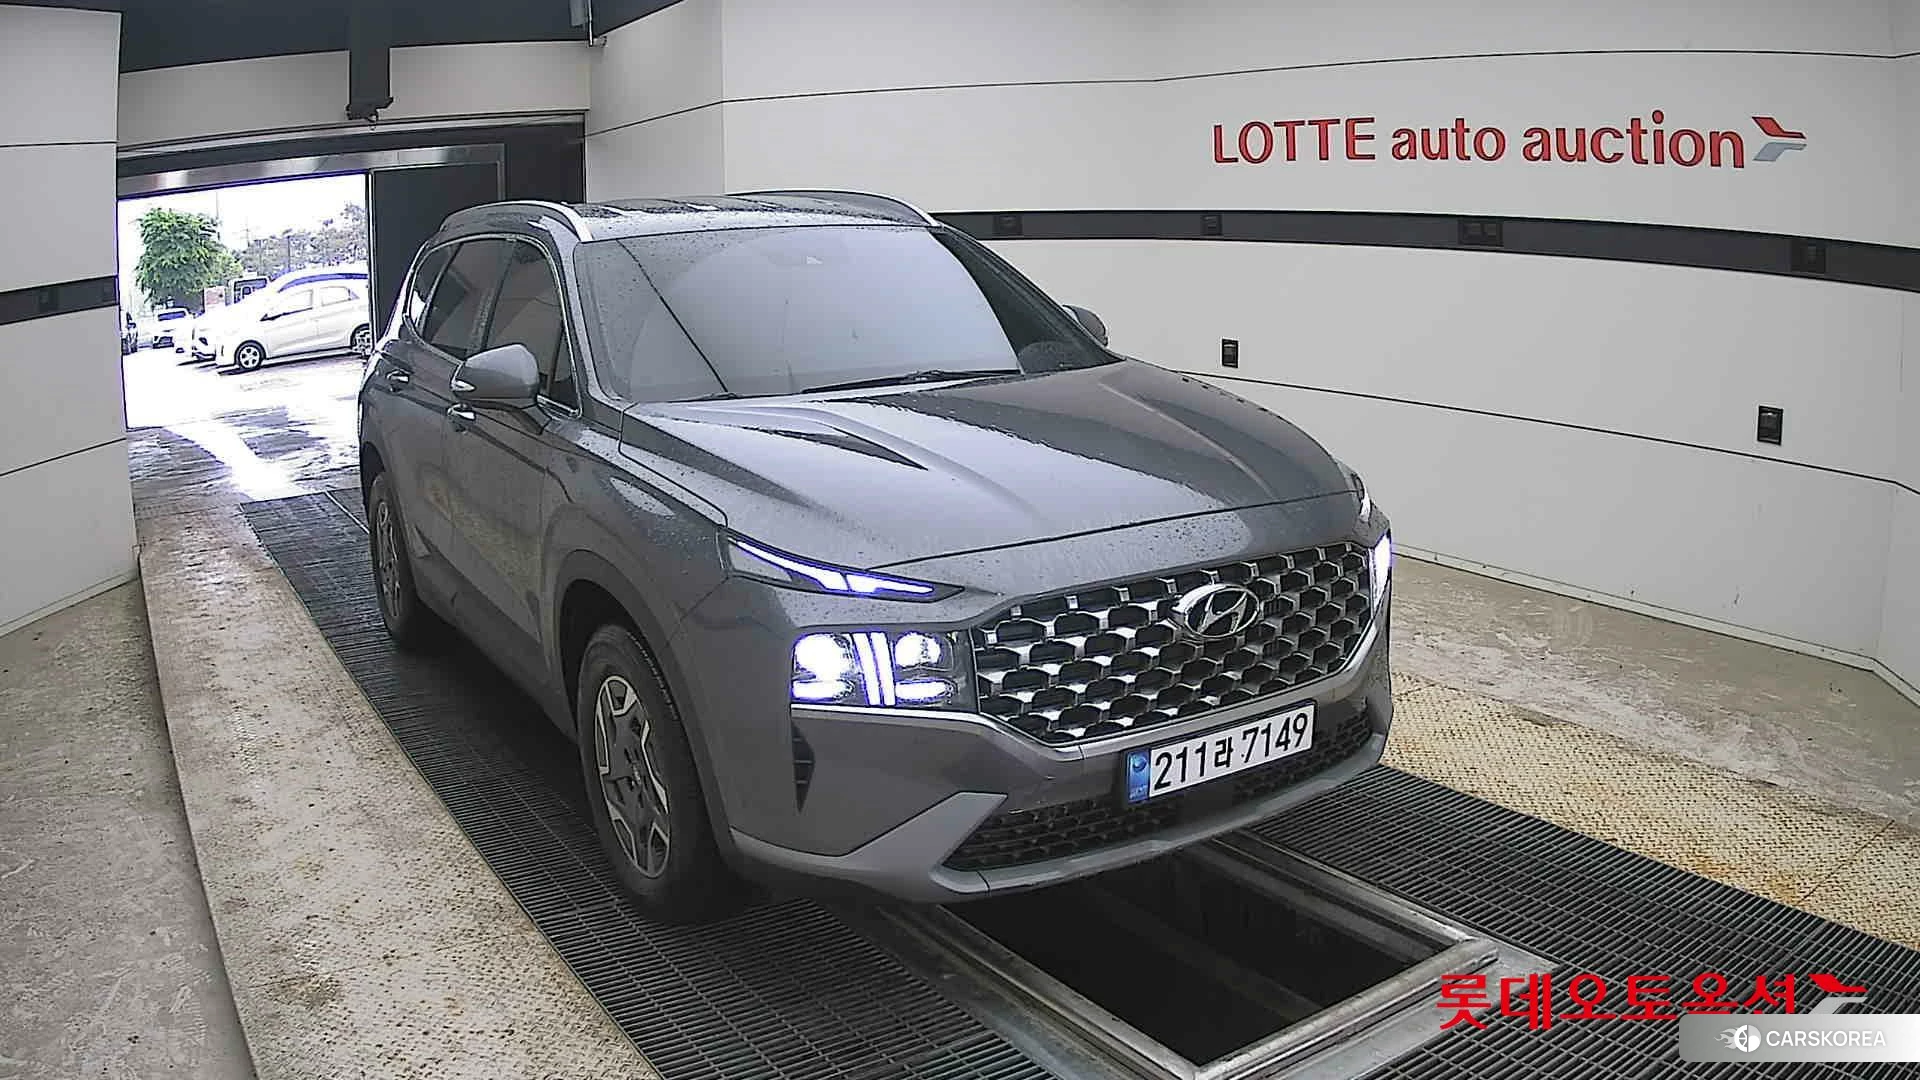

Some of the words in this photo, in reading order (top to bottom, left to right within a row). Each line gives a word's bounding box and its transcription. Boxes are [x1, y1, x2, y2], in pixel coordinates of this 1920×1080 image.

[1212, 116, 1376, 164] LOTTE
[1391, 117, 1507, 162] auto
[1522, 110, 1745, 169] auction
